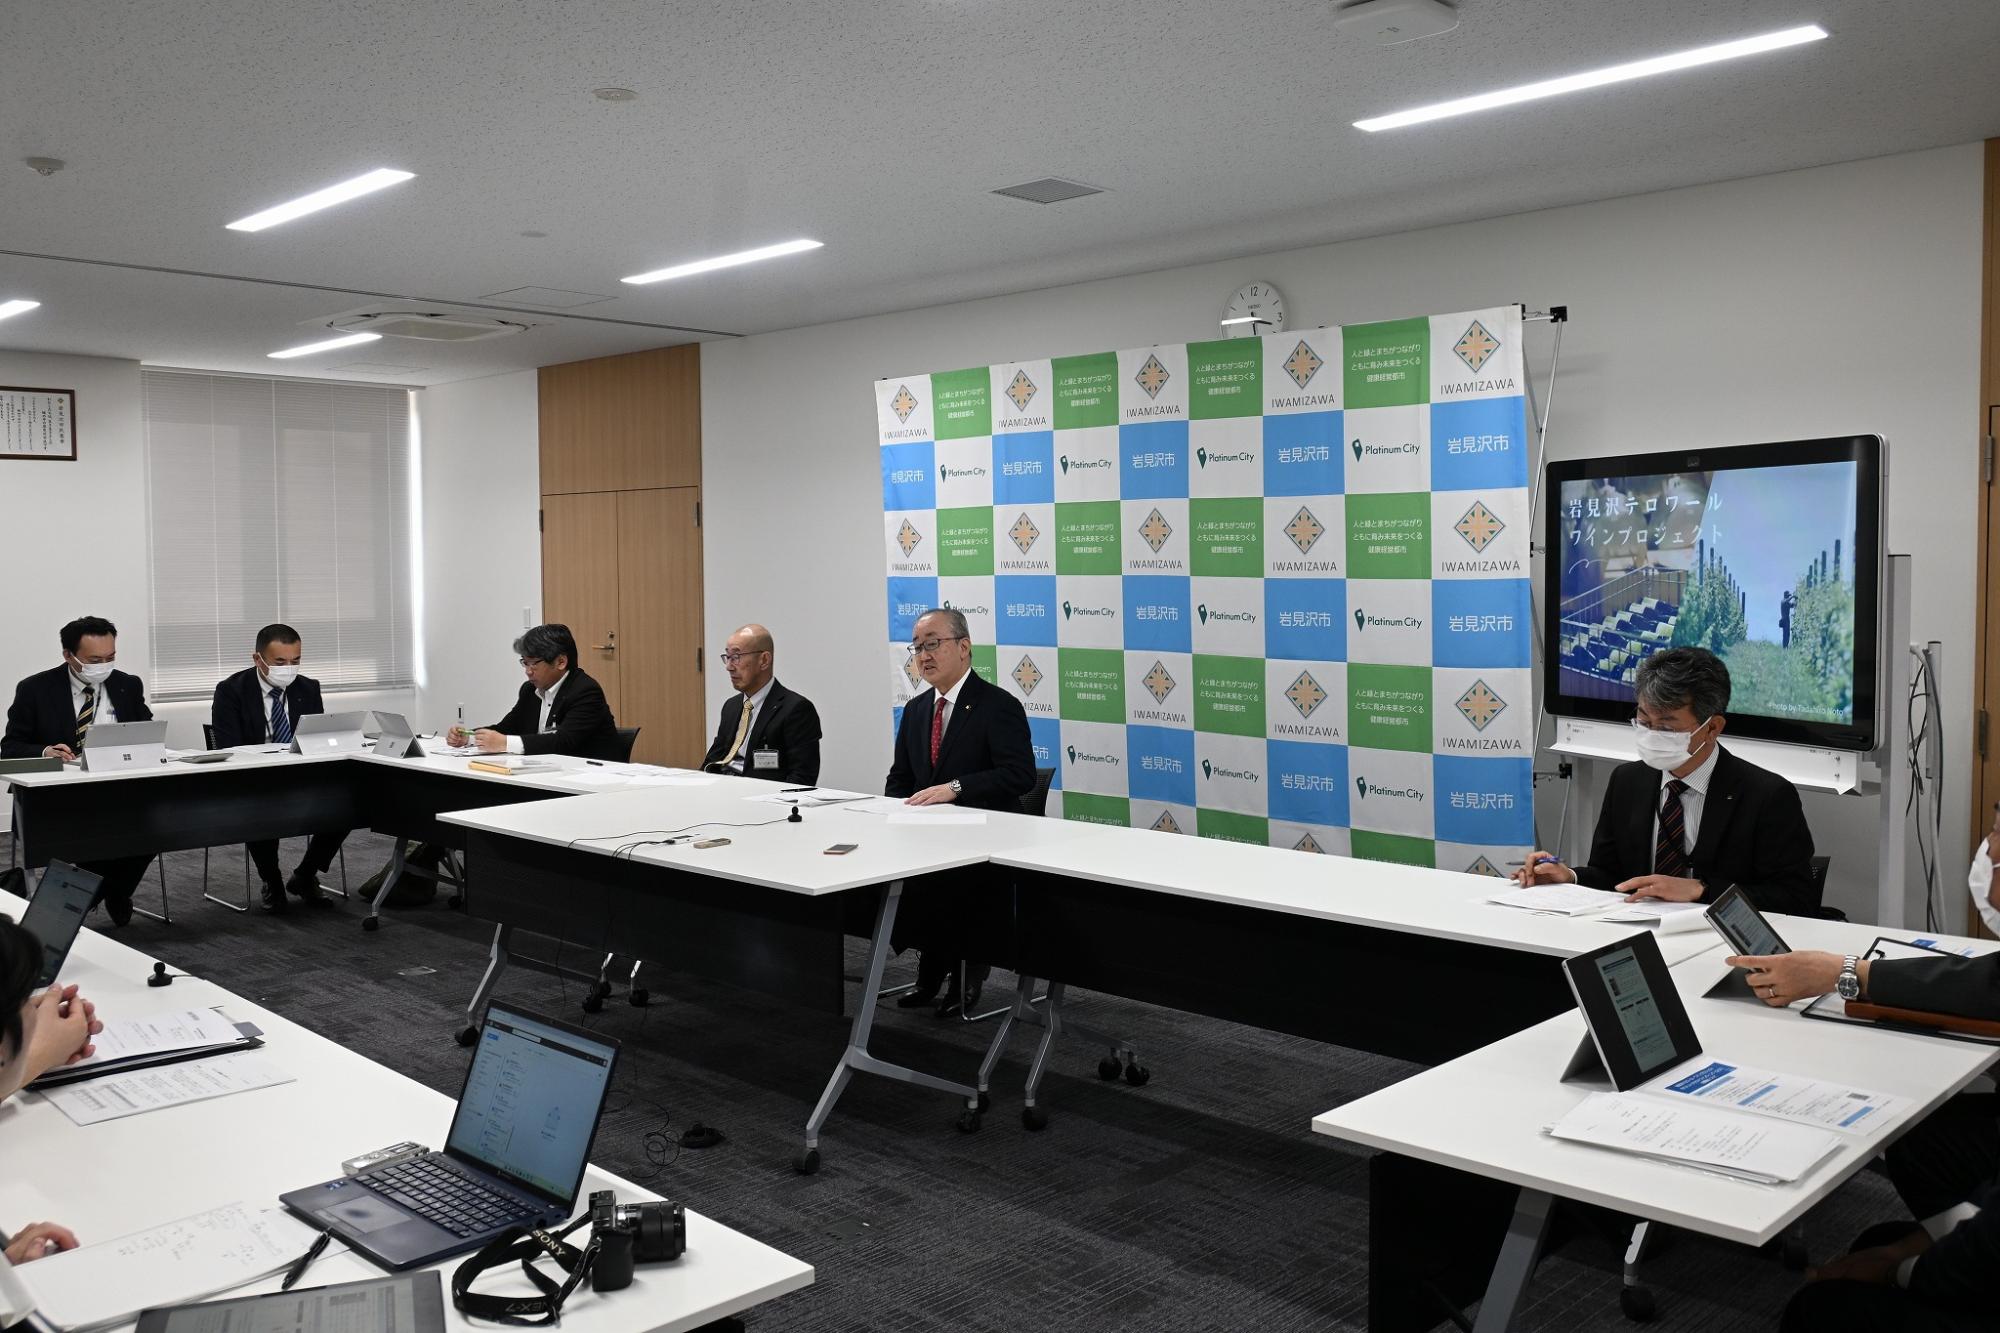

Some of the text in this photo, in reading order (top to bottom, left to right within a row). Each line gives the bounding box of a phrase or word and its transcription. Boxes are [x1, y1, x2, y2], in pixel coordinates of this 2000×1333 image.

[1250, 286, 1259, 297] 12
[1277, 312, 1283, 322] 3
[1351, 344, 1421, 358] 人と緑とまちがつながり
[1351, 357, 1421, 371] ともに育み未来をつくる
[1440, 379, 1515, 395] IWAMIZAWA
[1271, 394, 1335, 408] IWAMIZAWA
[1126, 405, 1180, 418] IWAMIZAWA
[998, 417, 1047, 428] IWAMIZAWA
[1365, 443, 1420, 456] Platinum City
[1447, 435, 1509, 454] 岩見沢市
[1132, 453, 1175, 468] 岩見沢市
[1208, 452, 1255, 464] Platinum City
[1278, 447, 1329, 463] 岩見沢市
[1002, 461, 1042, 476] 岩見沢市
[1070, 459, 1112, 470] Platinum City
[948, 467, 986, 478] Platinum City
[1568, 493, 1723, 518] 岩見沢テロワール
[1353, 519, 1423, 529] 人と緑とまちがつながり
[1352, 532, 1423, 541] ともに育み未来をつくる
[1568, 524, 1723, 546] ワインプロジェクト
[1000, 560, 1049, 570] IWAMIZAWA
[1129, 559, 1183, 570] IWAMIZAWA
[1272, 561, 1337, 572] IWAMIZAWA
[1441, 560, 1521, 573] IWAMIZAWA
[976, 605, 989, 615] City
[1006, 604, 1045, 617] 岩見沢市
[1073, 607, 1115, 618] Platinum City
[1136, 606, 1179, 621] 岩見沢市
[1209, 611, 1257, 624] Platinum City
[1279, 612, 1331, 628] 岩見沢市
[1367, 616, 1422, 630] Platinum City
[1449, 616, 1513, 632] 岩見沢市
[1355, 689, 1424, 701] 人と緑とまちがつながり
[1023, 702, 1054, 712] IZAWA
[1355, 701, 1425, 714] ともに育み未来をつくる
[1788, 703, 1796, 712] by
[1134, 710, 1187, 724] IWAMIZAWA
[1274, 724, 1339, 737] IWAMIZAWA
[1442, 738, 1522, 750] IWAMIZAWA
[1077, 751, 1120, 766] Platinum City
[1141, 756, 1182, 773] 岩見沢市
[1213, 766, 1259, 782] Platinum City
[1281, 773, 1334, 792] 岩見沢市
[1369, 784, 1424, 801] Platinum City
[1450, 791, 1514, 809] 岩見沢市
[532, 1229, 566, 1256] SONY
